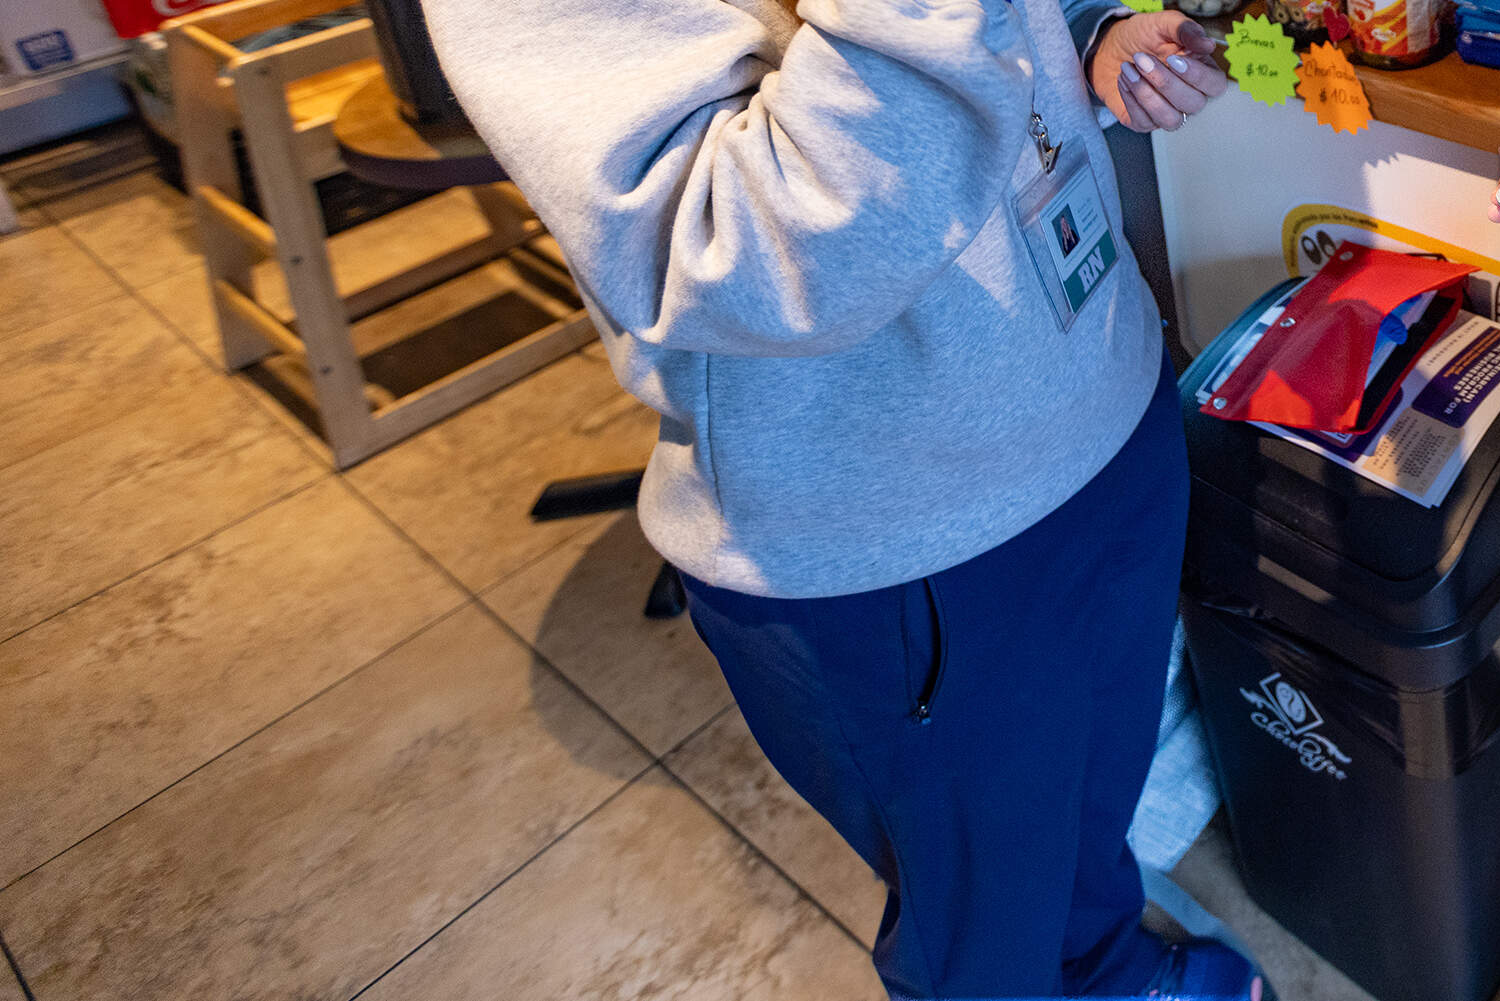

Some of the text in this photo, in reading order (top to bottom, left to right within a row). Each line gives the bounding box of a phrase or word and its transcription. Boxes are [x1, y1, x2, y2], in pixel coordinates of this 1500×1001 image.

[1078, 245, 1105, 295] RN
[1458, 363, 1494, 397] PROGRAM
[1444, 397, 1461, 415] FOR
